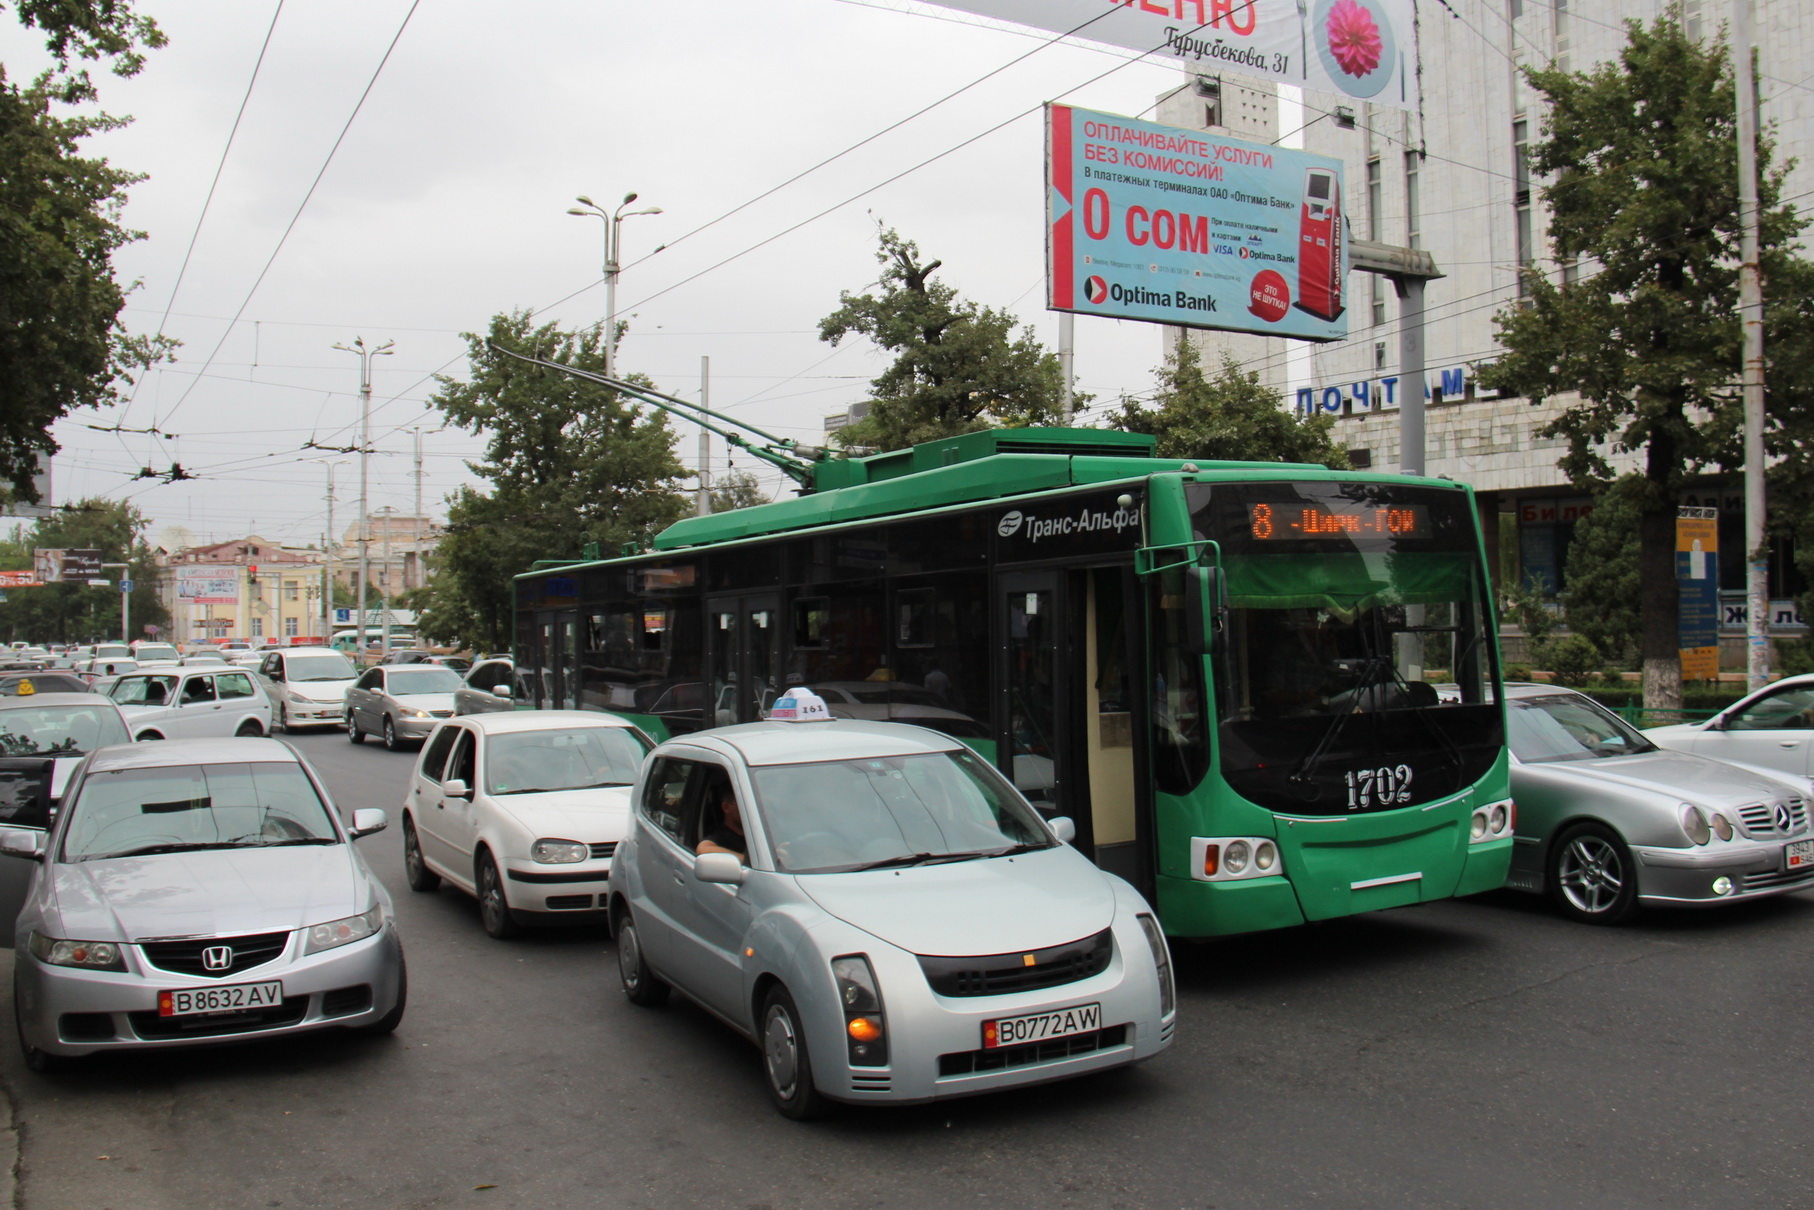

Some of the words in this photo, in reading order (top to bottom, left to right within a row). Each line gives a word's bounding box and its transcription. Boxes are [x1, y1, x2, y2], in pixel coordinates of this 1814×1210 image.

[1164, 26, 1268, 72] Турусбекова,
[1272, 52, 1289, 75] 31
[1084, 121, 1209, 158] ОПЛАЧИВАЙТЕ
[1212, 143, 1273, 169] УСЛУГИ
[1084, 143, 1118, 165] БЕЗ
[1123, 150, 1224, 181] КОМИССИЙ!
[1084, 166, 1091, 177] В
[1094, 170, 1151, 187] платежных
[1152, 180, 1208, 197] терминалах
[1210, 187, 1228, 200] ОАО
[1125, 205, 1209, 254] СОМ
[1213, 243, 1233, 255] VISA
[1249, 250, 1276, 261] Optima
[1276, 251, 1295, 264] Bank
[1110, 283, 1171, 306] Optima
[1176, 291, 1217, 312] Bank
[1252, 290, 1261, 301] НЕ
[1262, 295, 1286, 310] ШУТКА!
[1264, 284, 1278, 297] ЭТО
[1025, 506, 1139, 543] Транс-Альфа
[1253, 503, 1272, 539] 8
[802, 705, 824, 714] 161
[1344, 764, 1413, 809] 1702
[1000, 1006, 1098, 1042] B0772AW
